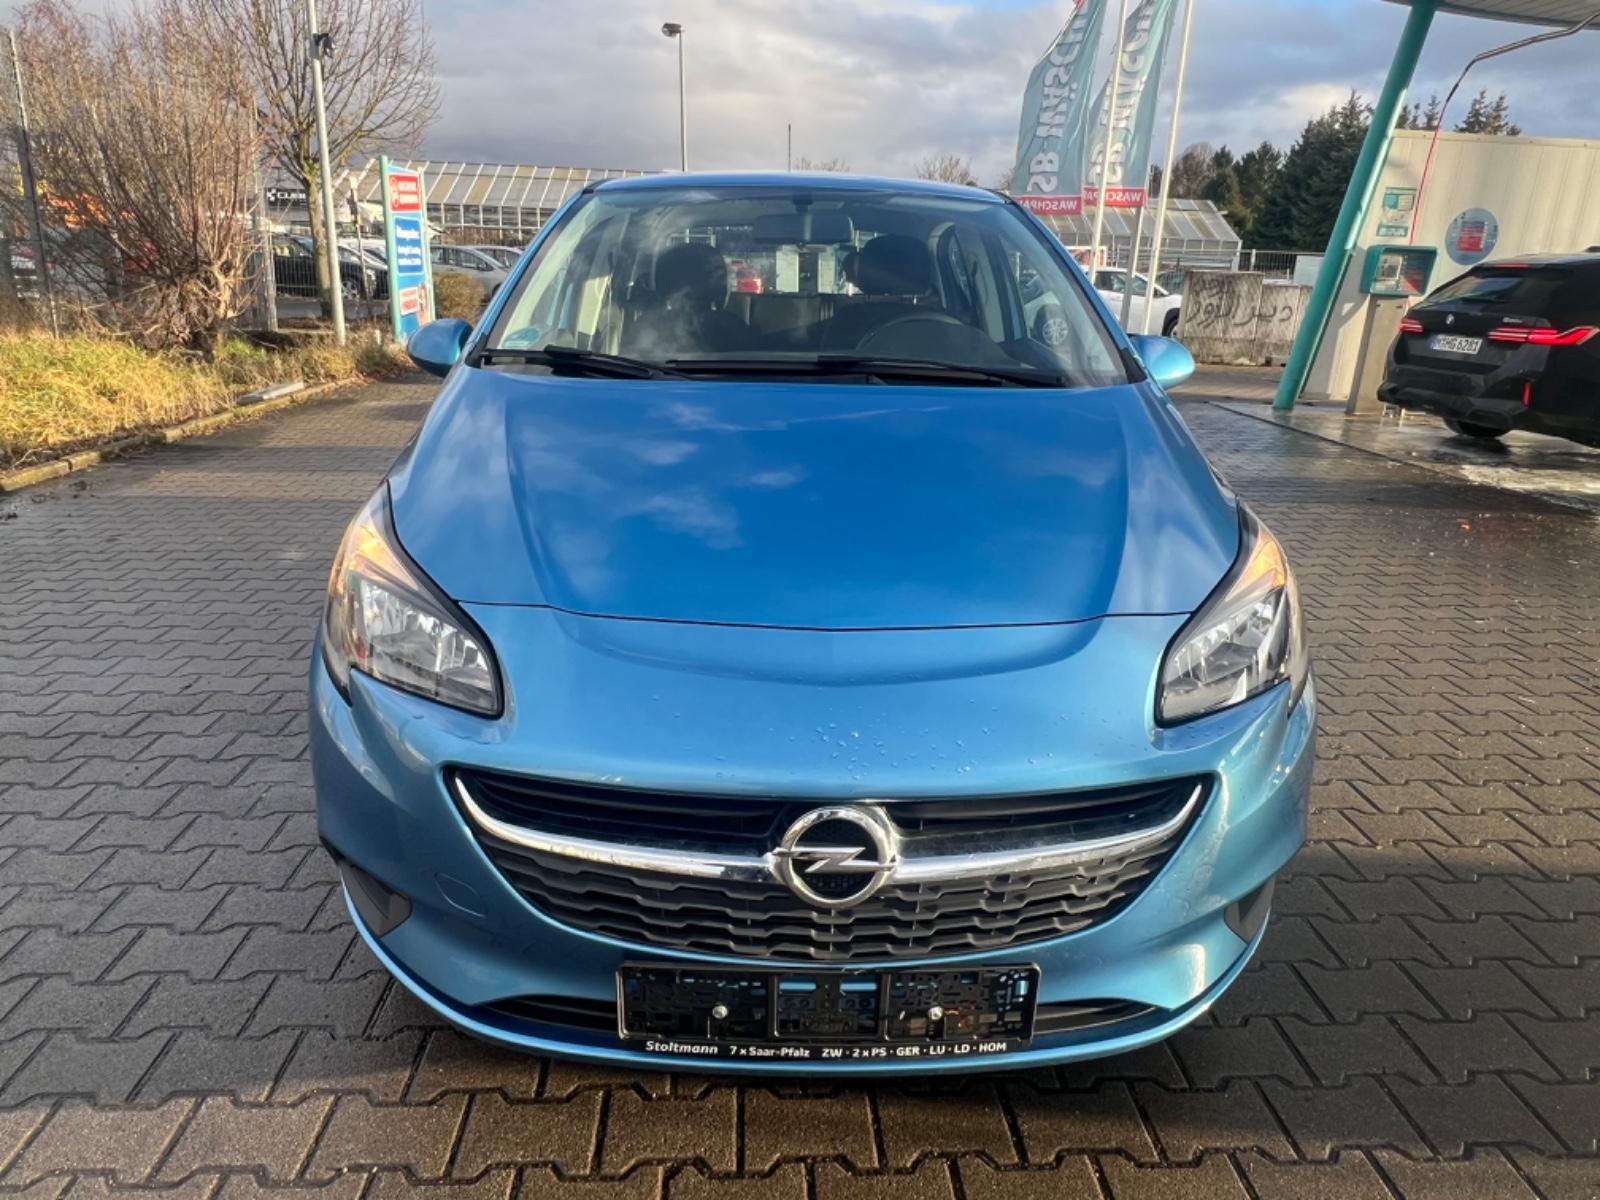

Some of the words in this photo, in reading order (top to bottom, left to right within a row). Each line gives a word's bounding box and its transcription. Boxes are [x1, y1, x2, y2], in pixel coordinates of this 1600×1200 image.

[645, 1040, 719, 1054] Stoltmann
[729, 1045, 738, 1055] 7
[749, 1046, 811, 1058] Saar-Pfalz
[821, 1048, 843, 1058] ZW
[852, 1048, 861, 1058] 2
[871, 1046, 888, 1057] PS
[895, 1046, 920, 1057] GER
[929, 1045, 946, 1055] LU
[953, 1043, 971, 1054] LD
[978, 1041, 1008, 1053] HOM
